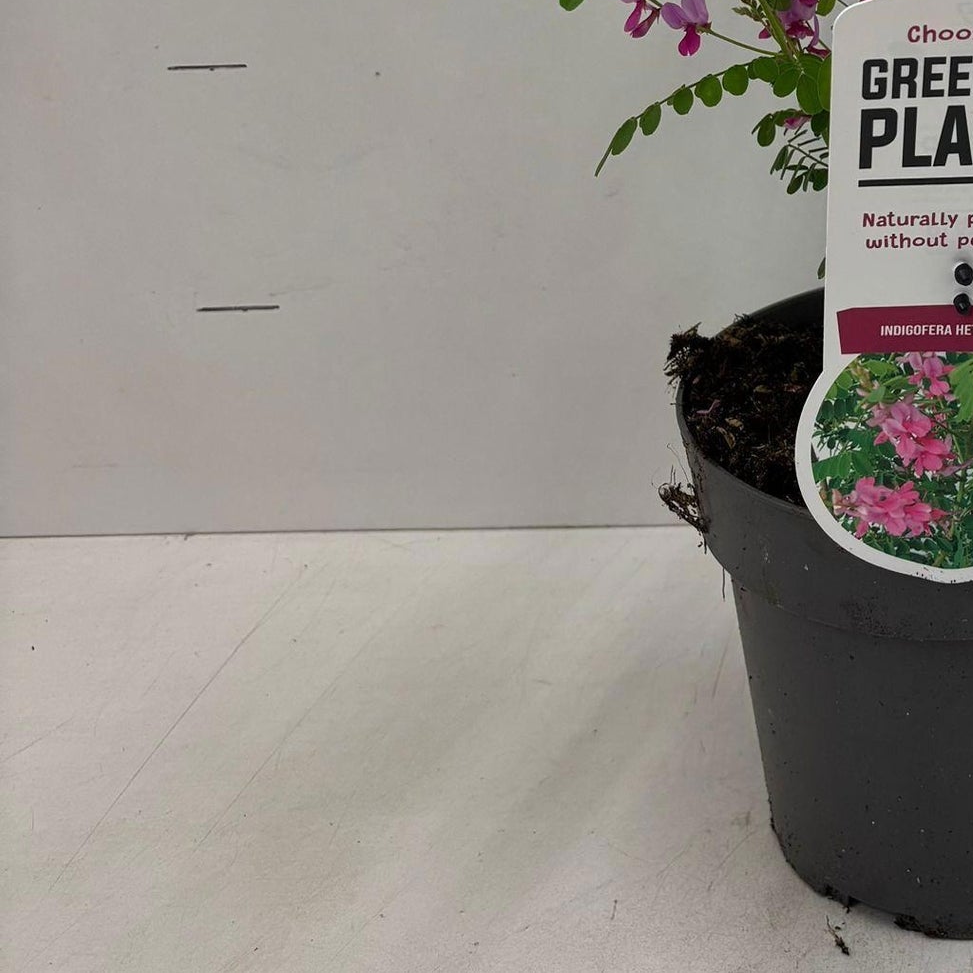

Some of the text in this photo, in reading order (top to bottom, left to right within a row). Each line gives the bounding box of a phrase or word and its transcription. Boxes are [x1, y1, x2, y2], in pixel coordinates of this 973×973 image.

[862, 211, 959, 229] Naturally
[865, 231, 949, 250] without
[880, 324, 953, 337] INDIGOFERA
